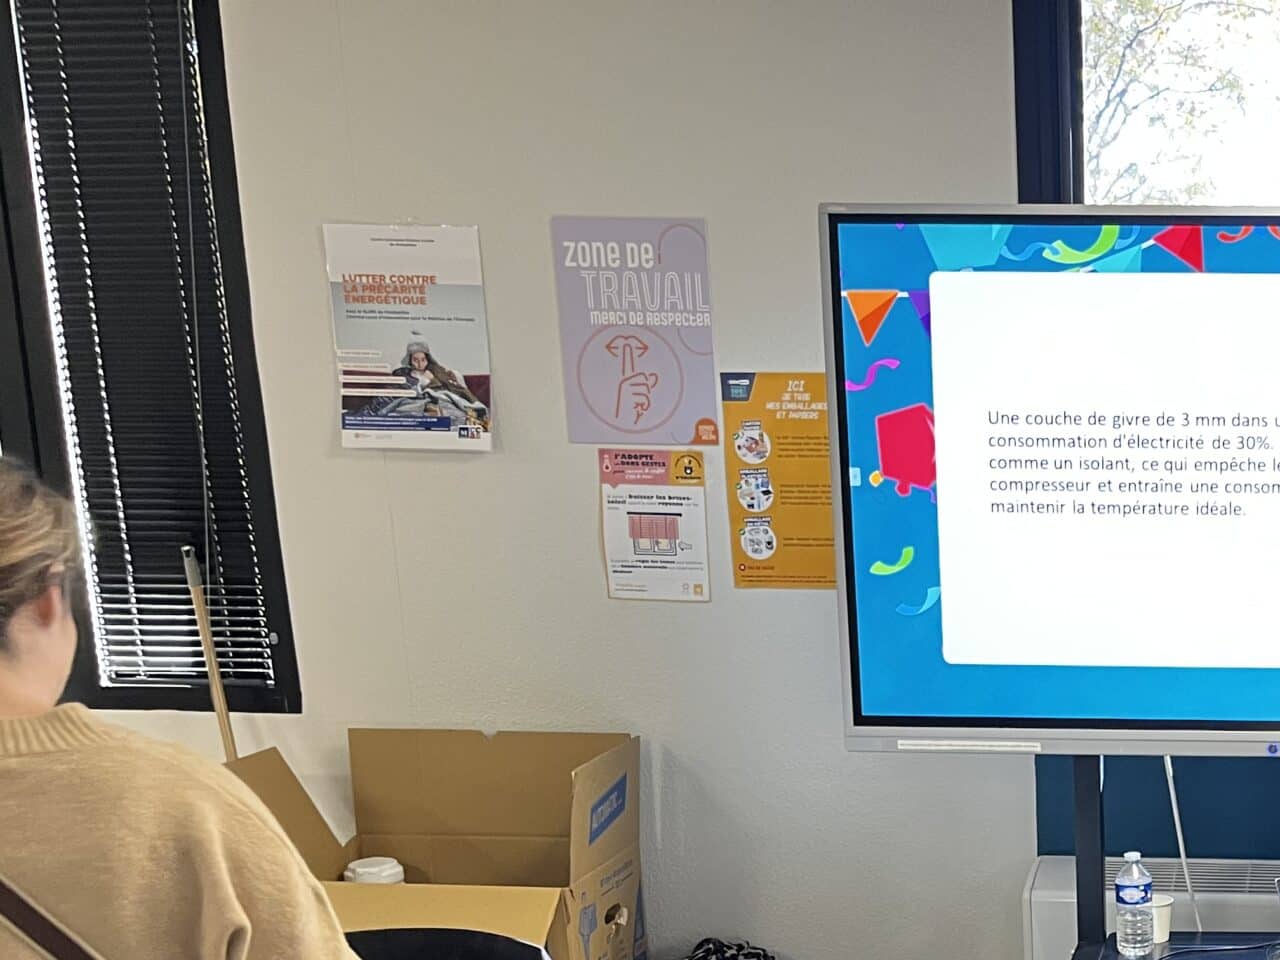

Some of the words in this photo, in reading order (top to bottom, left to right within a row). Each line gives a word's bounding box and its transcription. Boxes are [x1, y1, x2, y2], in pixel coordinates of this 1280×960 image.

[342, 273, 387, 284] LUTTER
[389, 275, 437, 285] CONTRE
[344, 285, 361, 294] LA
[362, 284, 427, 296] PRÉCARITÉ
[580, 270, 711, 312] TRAVAIL
[787, 380, 805, 392] ICI
[989, 411, 1019, 424] Une
[1026, 411, 1082, 425] couche
[1088, 411, 1106, 425] de
[1113, 413, 1150, 429] givre
[1156, 412, 1175, 426] de
[1182, 413, 1189, 426] 3
[1196, 416, 1225, 426] mm
[1232, 413, 1267, 427] dans
[989, 436, 1107, 448] consommation
[1113, 434, 1204, 449] d'électricité
[1212, 436, 1230, 449] de
[1237, 436, 1274, 449] 30%.
[989, 459, 1048, 469] comme
[1054, 460, 1072, 469] un
[1080, 456, 1134, 472] isolant,
[1142, 461, 1159, 471] ce
[1164, 460, 1187, 474] qui
[1195, 457, 1266, 474] empêche
[990, 481, 1090, 494] compresseur
[1098, 480, 1112, 492] et
[1119, 478, 1182, 492] entraîne
[1191, 483, 1218, 493] une
[991, 502, 1065, 513] maintenir
[1073, 500, 1084, 514] la
[1091, 501, 1189, 517] température
[1197, 501, 1246, 515] idéale.
